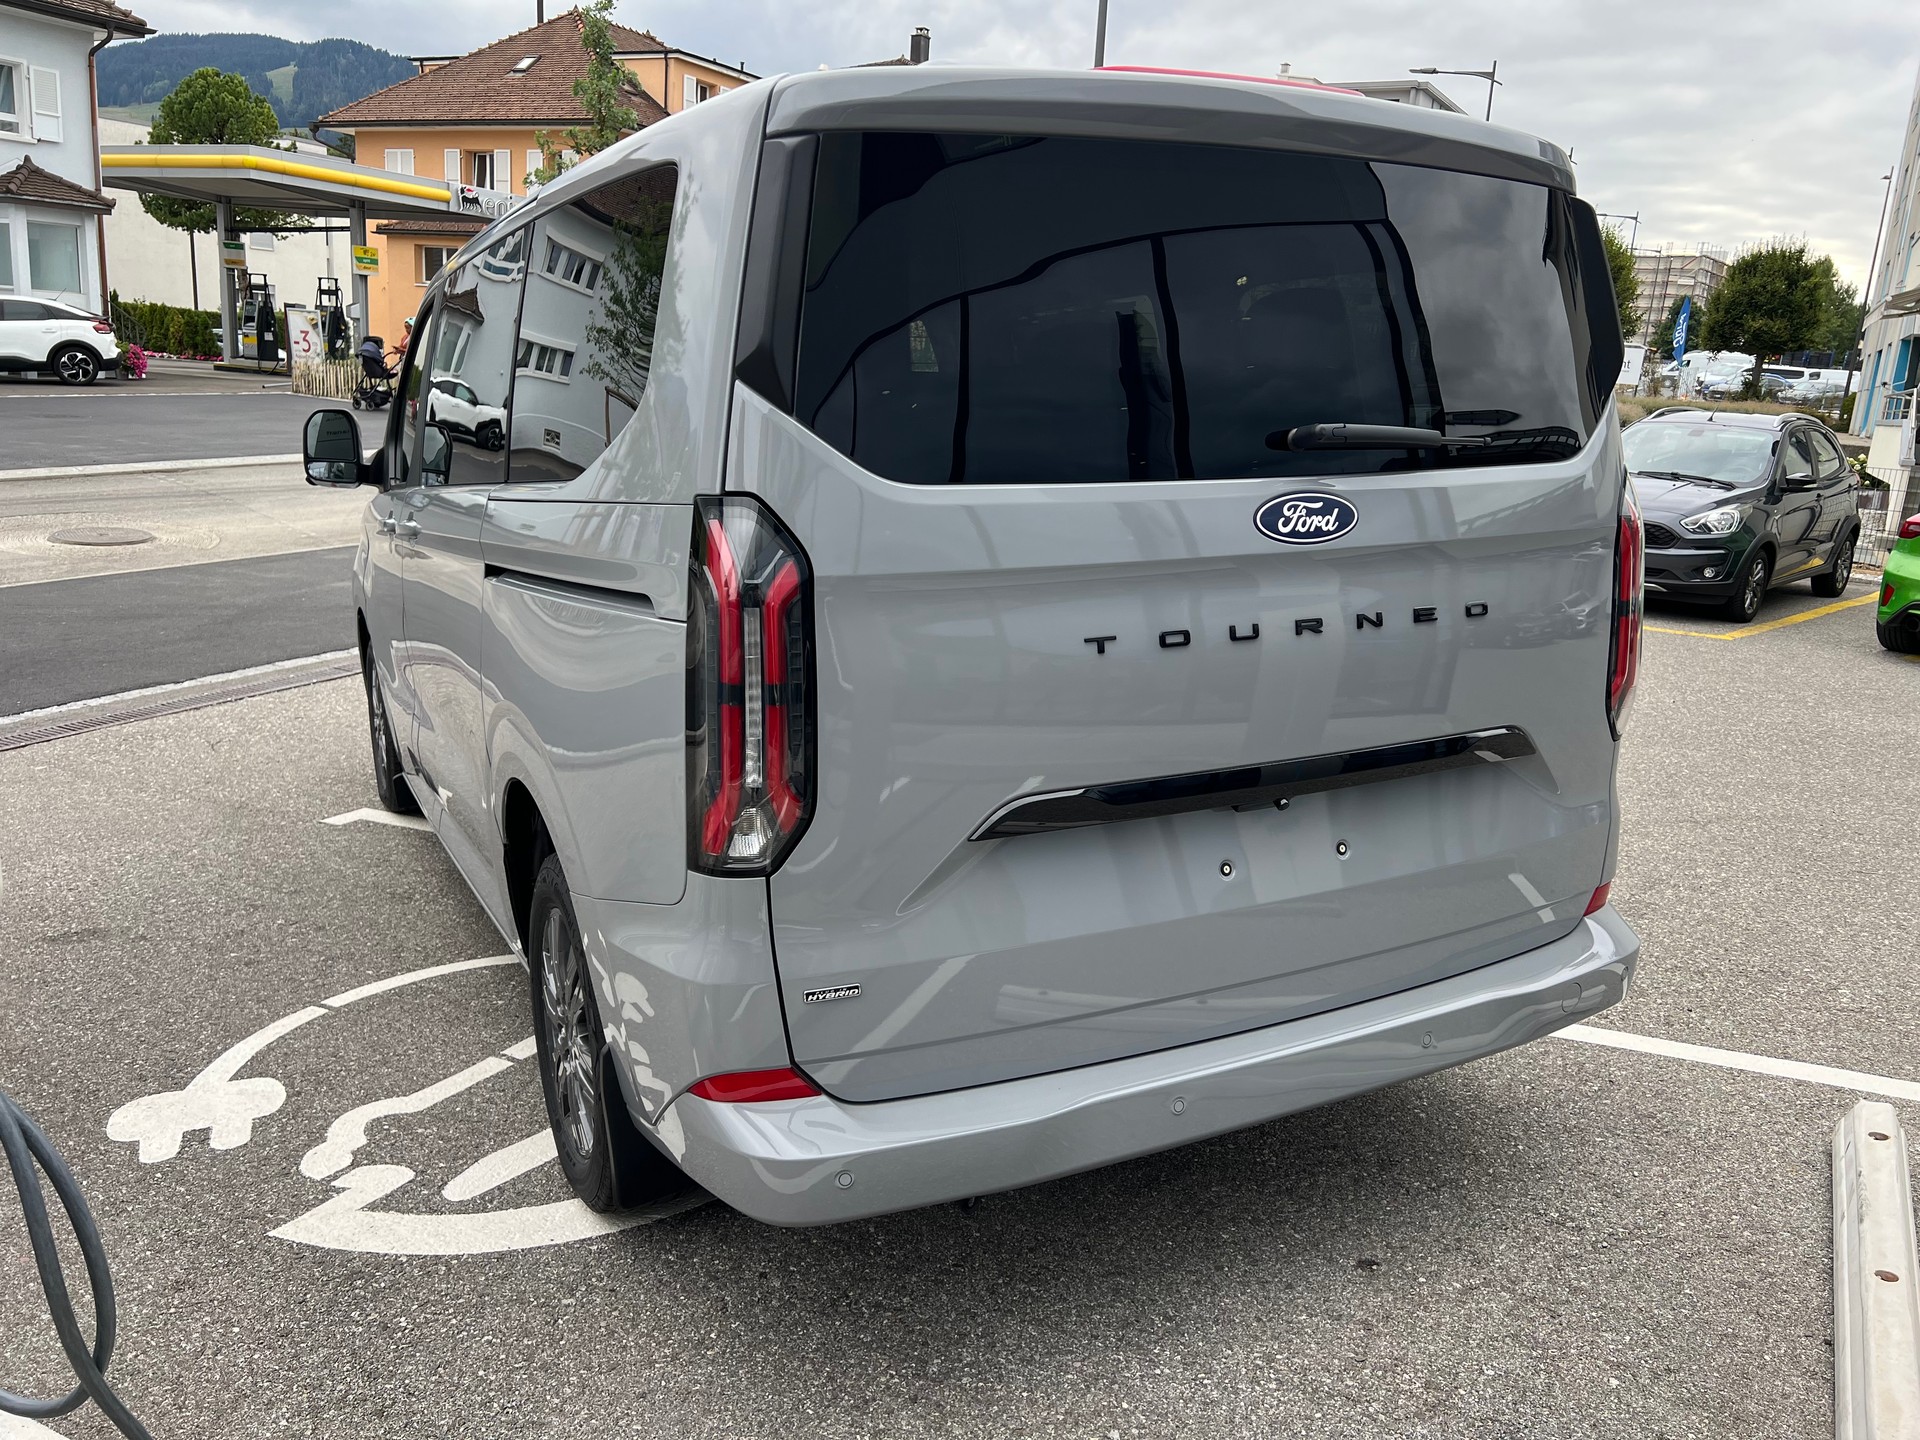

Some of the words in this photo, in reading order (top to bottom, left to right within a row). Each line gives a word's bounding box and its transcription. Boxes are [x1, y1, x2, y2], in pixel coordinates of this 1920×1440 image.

[483, 195, 514, 216] eni
[1278, 501, 1339, 533] Ford
[1083, 600, 1489, 654] TOURNEO
[807, 989, 859, 1001] HYBRID
